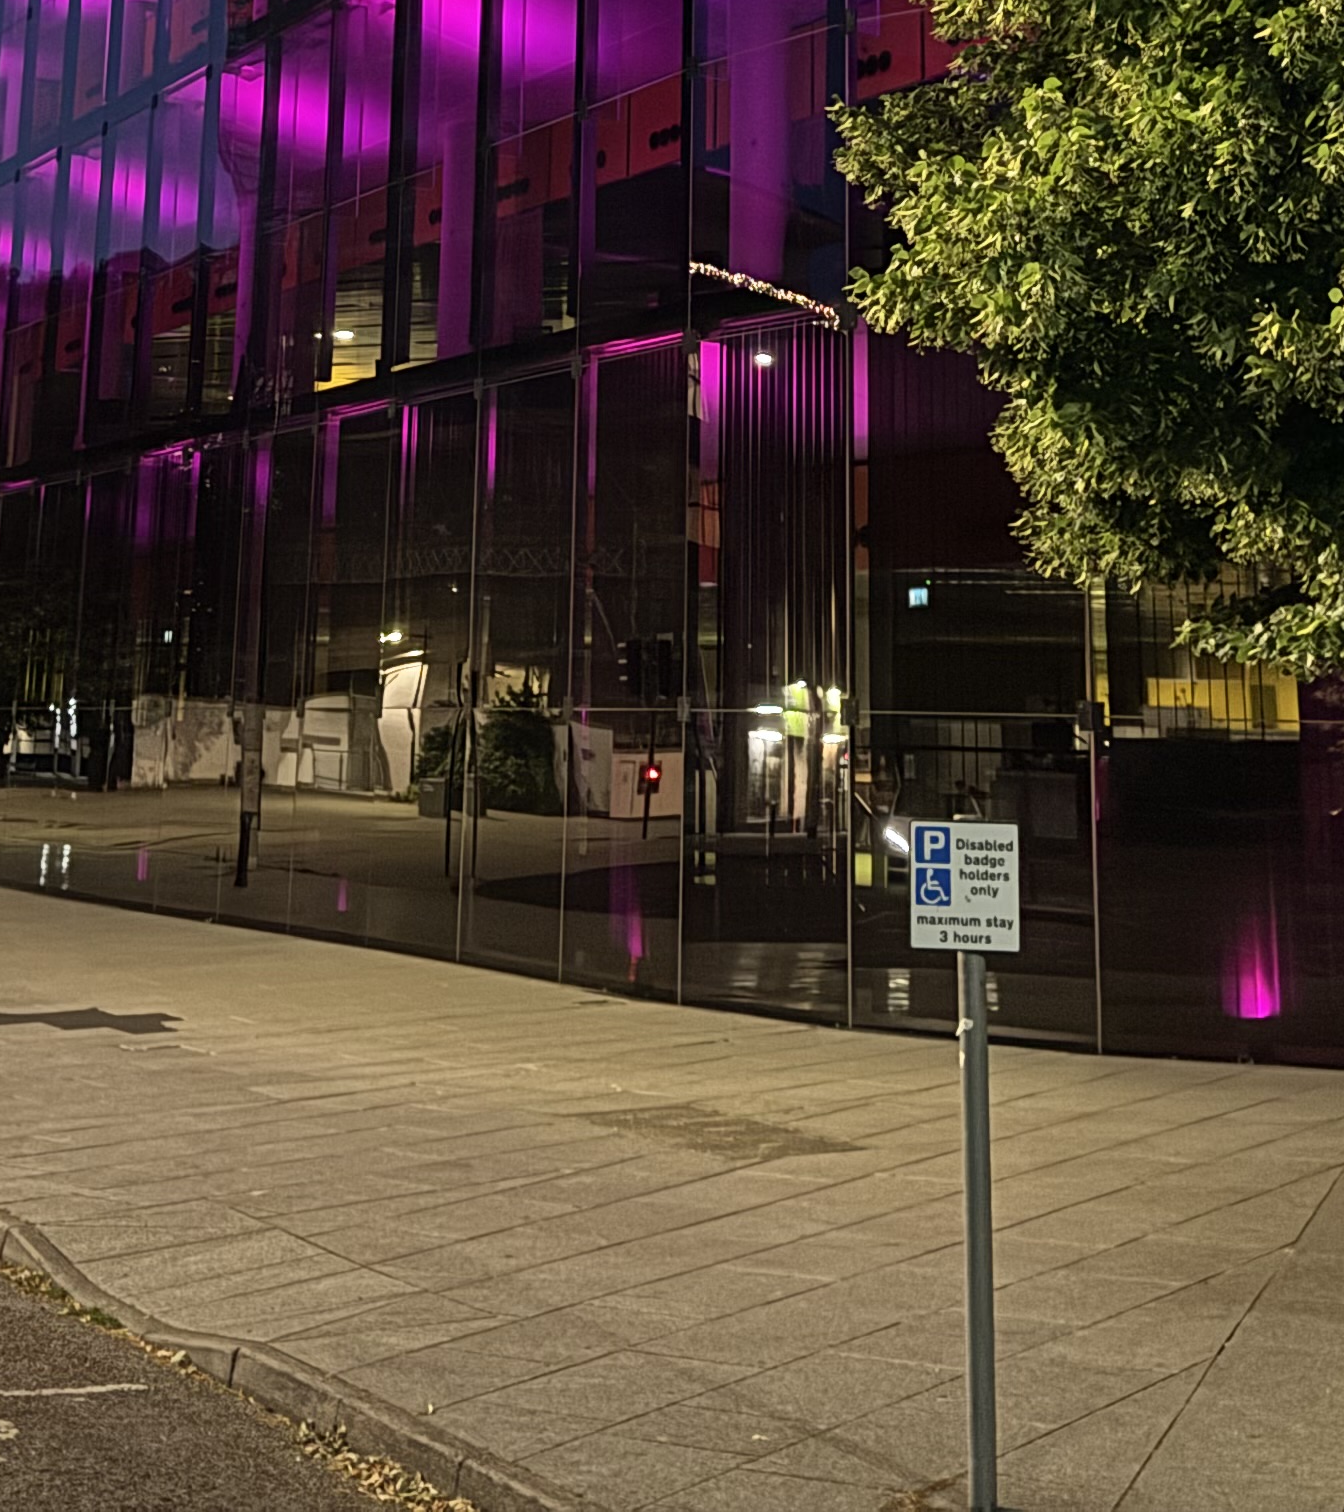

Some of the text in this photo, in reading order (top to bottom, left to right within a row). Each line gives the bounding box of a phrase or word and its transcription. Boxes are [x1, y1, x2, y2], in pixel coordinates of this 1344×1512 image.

[923, 830, 946, 861] P
[955, 838, 1014, 852] Disabled
[964, 854, 1005, 868] badge
[959, 869, 1010, 882] holders
[970, 885, 999, 898] only
[917, 915, 1014, 930] maximum stay
[939, 931, 992, 945] 3 hours
